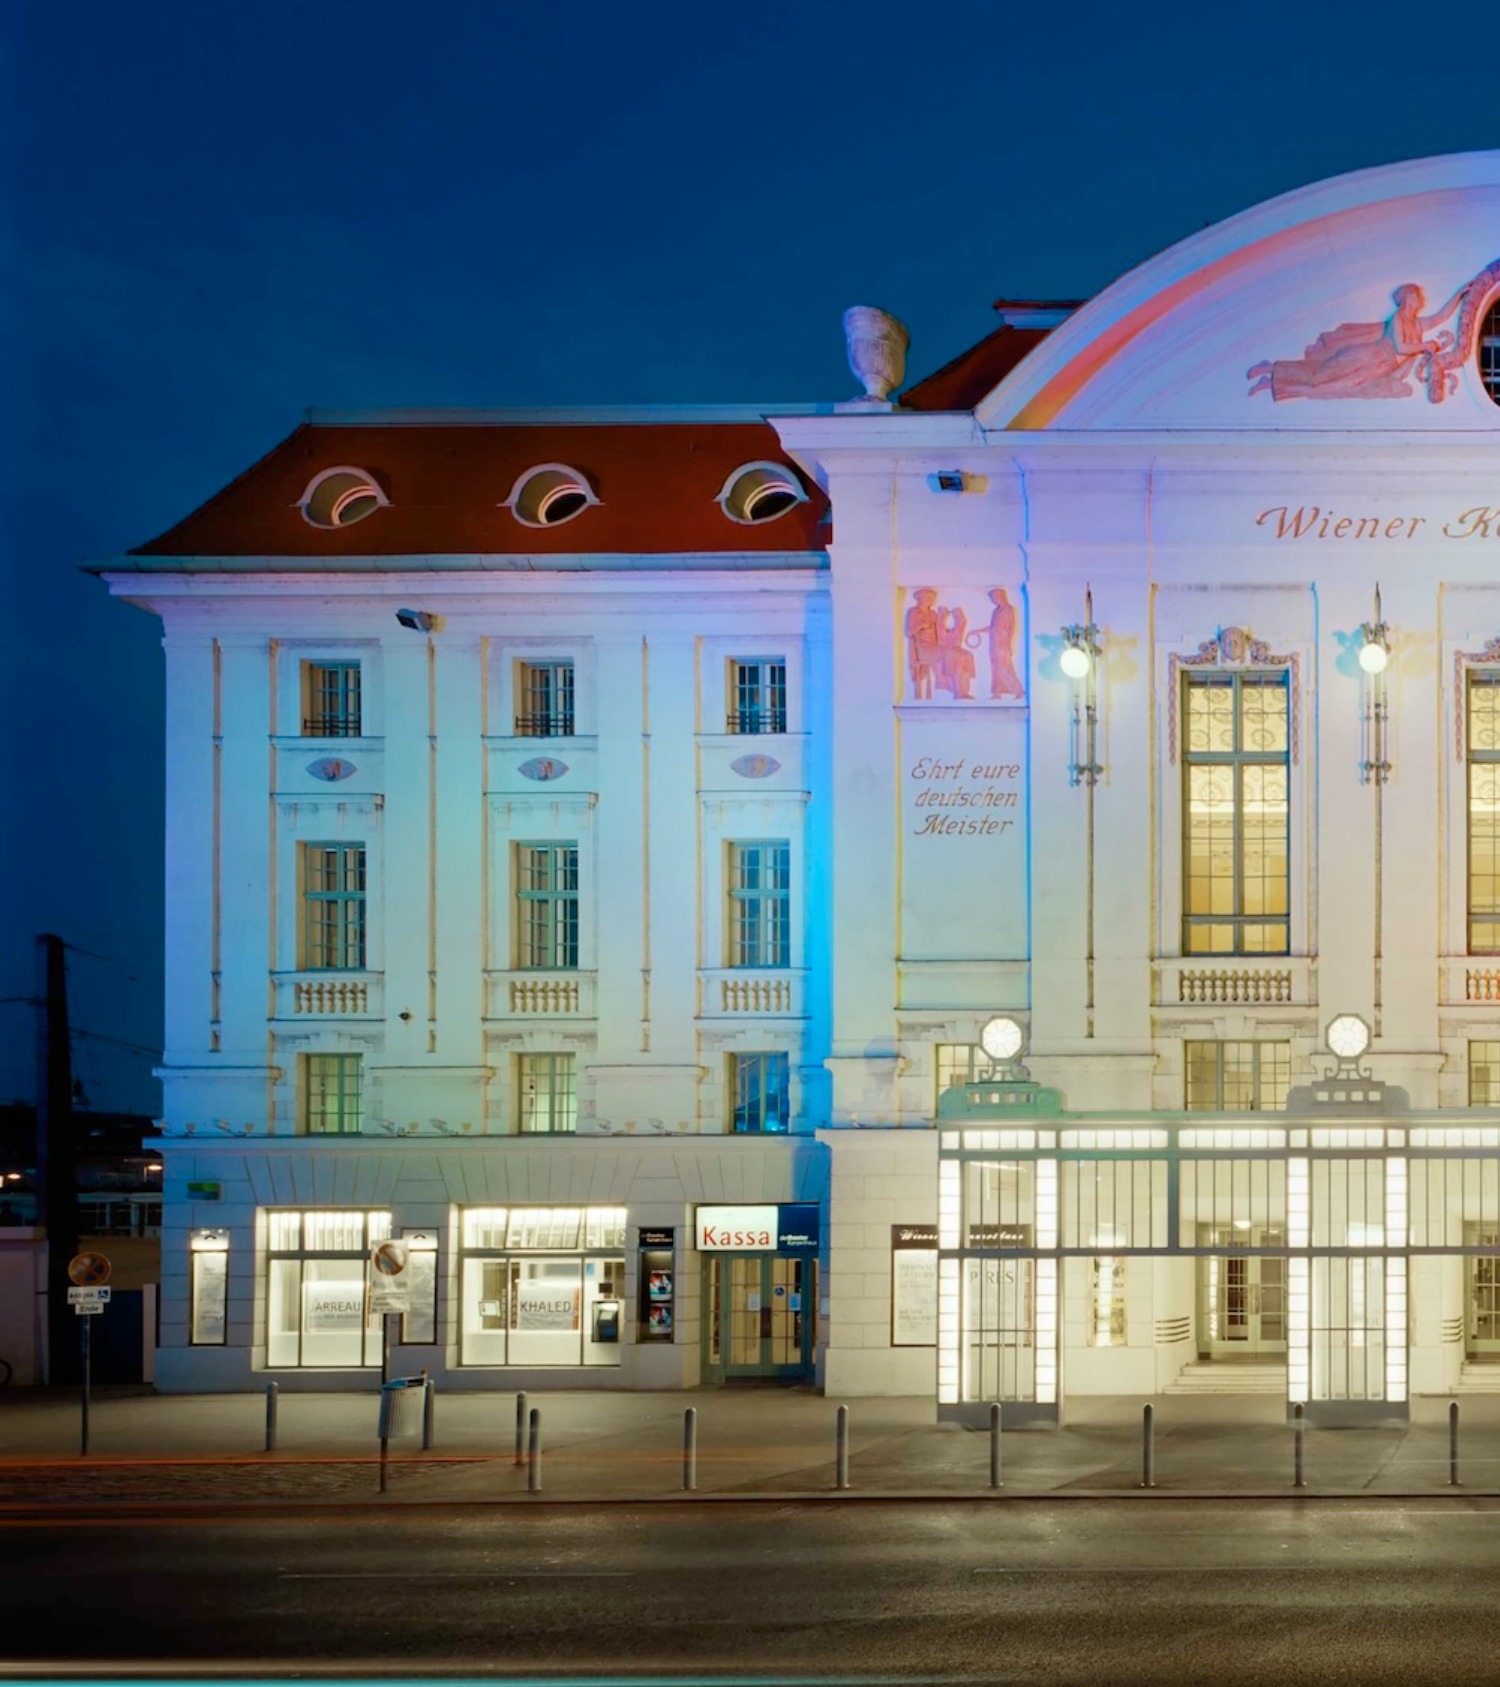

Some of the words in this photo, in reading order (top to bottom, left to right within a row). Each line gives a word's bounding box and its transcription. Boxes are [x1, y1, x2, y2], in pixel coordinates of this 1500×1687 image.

[1255, 505, 1427, 540] Wiener
[911, 757, 965, 780] Ehrt
[970, 763, 1021, 780] eure
[914, 785, 1018, 808] deutschen
[913, 813, 1014, 836] Meister
[703, 1225, 770, 1247] Kassa
[520, 1300, 572, 1313] KHALED
